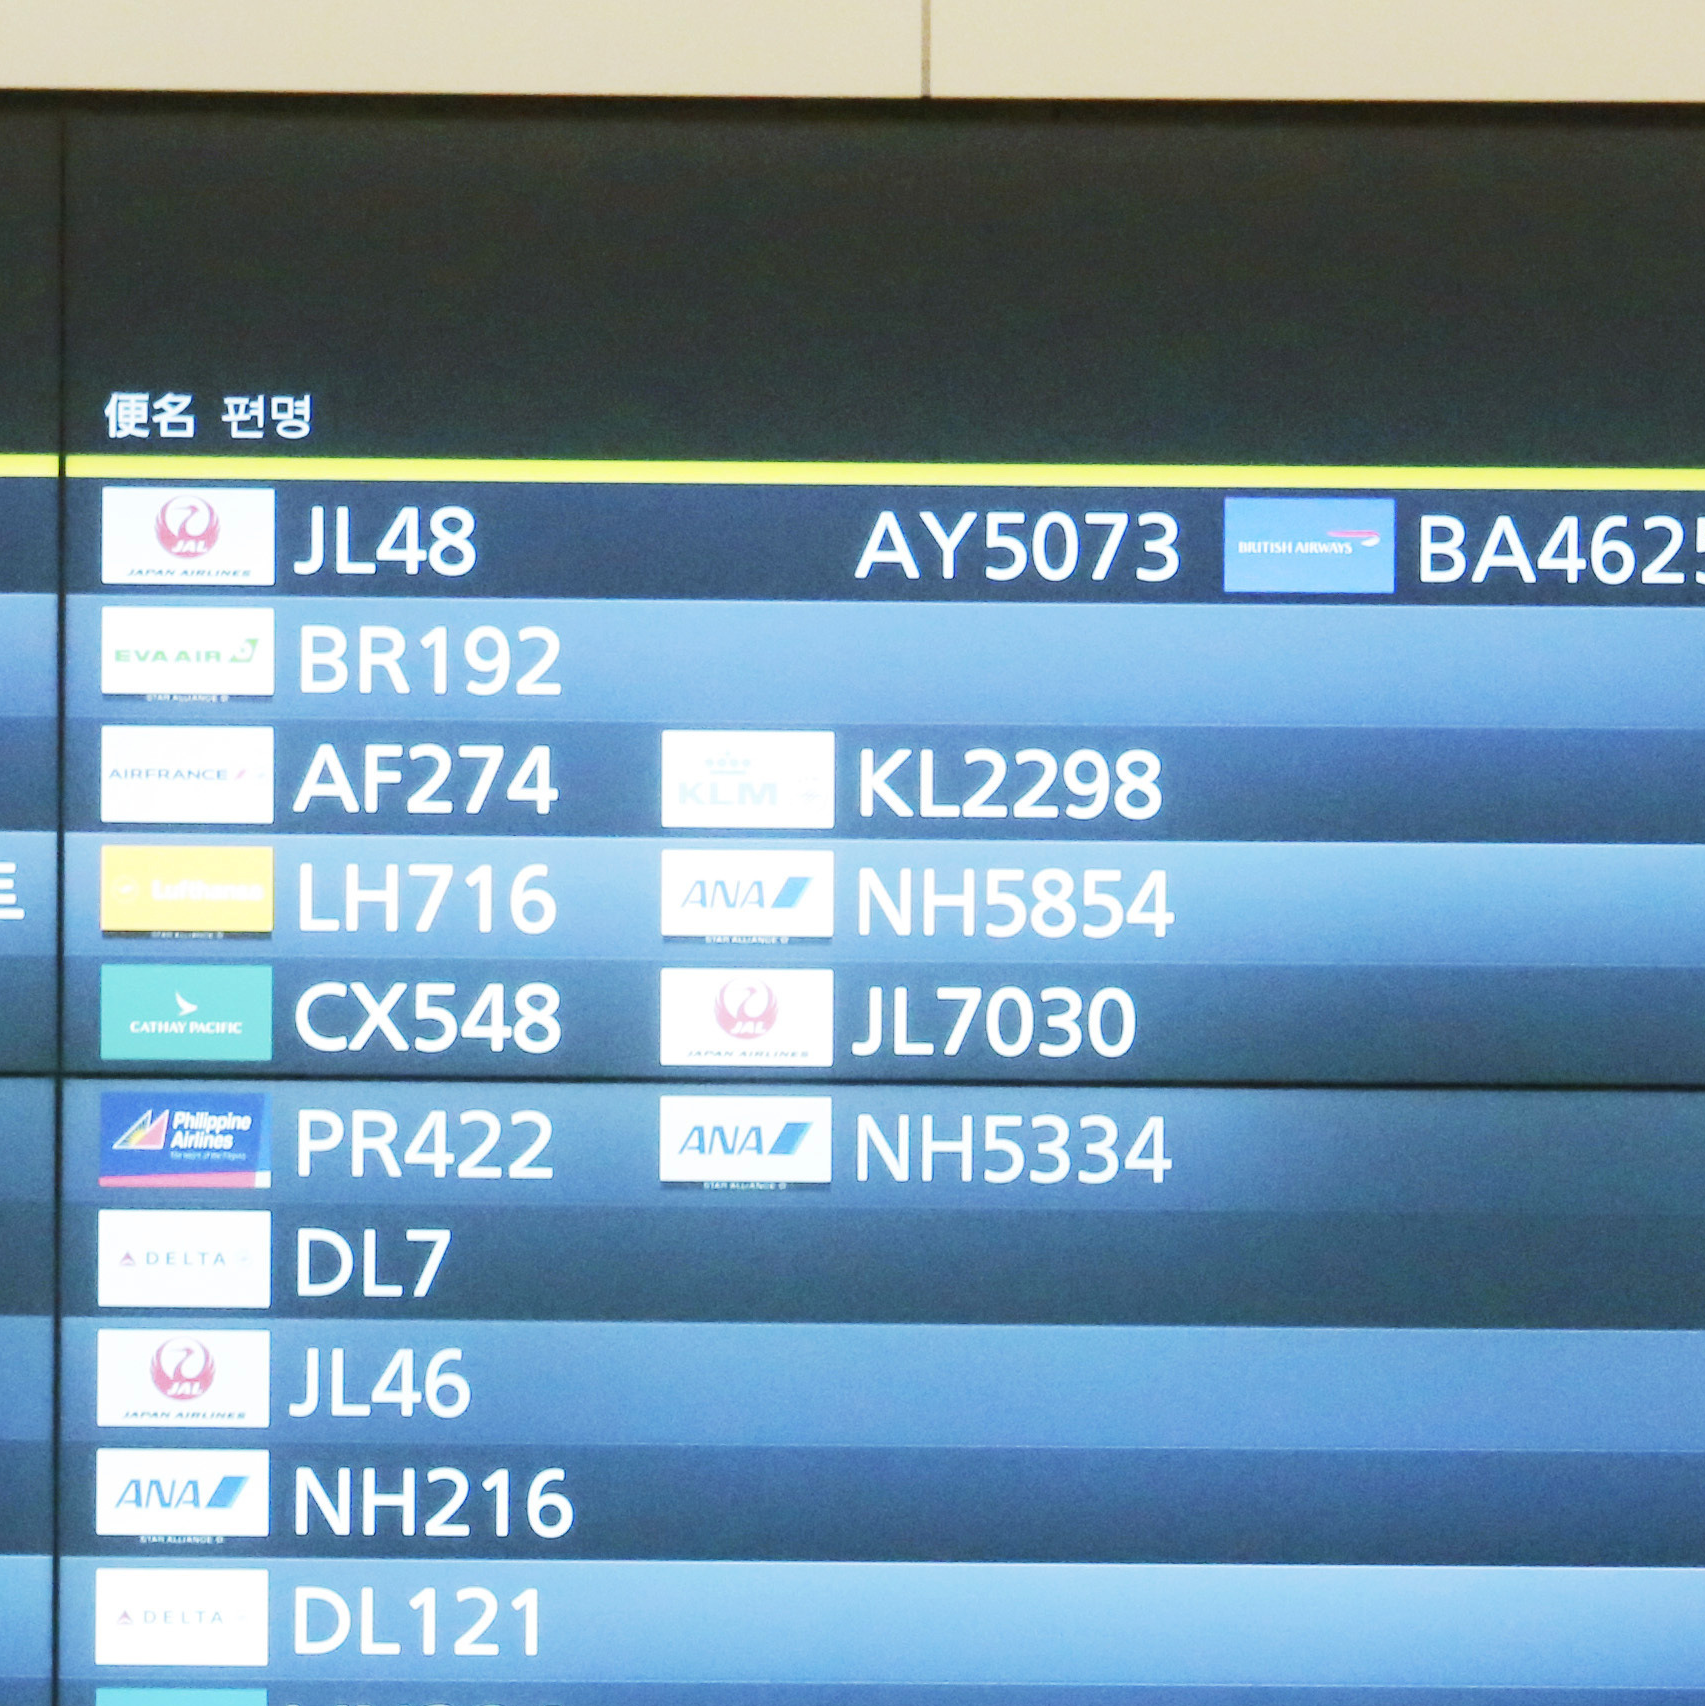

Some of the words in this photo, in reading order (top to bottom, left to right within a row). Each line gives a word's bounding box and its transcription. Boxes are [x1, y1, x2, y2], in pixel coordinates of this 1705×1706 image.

[104, 393, 194, 438] 便名
[221, 395, 310, 439] 편명
[294, 506, 476, 576] JL48
[855, 511, 1179, 582] AY5073
[300, 625, 562, 696] BR192
[293, 743, 559, 814] AF274
[860, 748, 1162, 820] KL2298
[299, 862, 557, 935] LH716
[858, 867, 1175, 939] NH5854
[130, 1020, 183, 1034] CATHAY
[187, 1020, 244, 1034] PACIFIC
[295, 982, 561, 1053] CX548
[852, 987, 1136, 1057] JL7030
[170, 1132, 234, 1150] Airlines
[173, 1111, 252, 1134] Philippine
[298, 1109, 553, 1179] PR422
[857, 1114, 1172, 1184] NH5334
[297, 1228, 450, 1297] DL7
[289, 1347, 470, 1418] JL46
[114, 1478, 200, 1510] ANA
[295, 1467, 573, 1538] NH216
[294, 1586, 538, 1656] DL121
